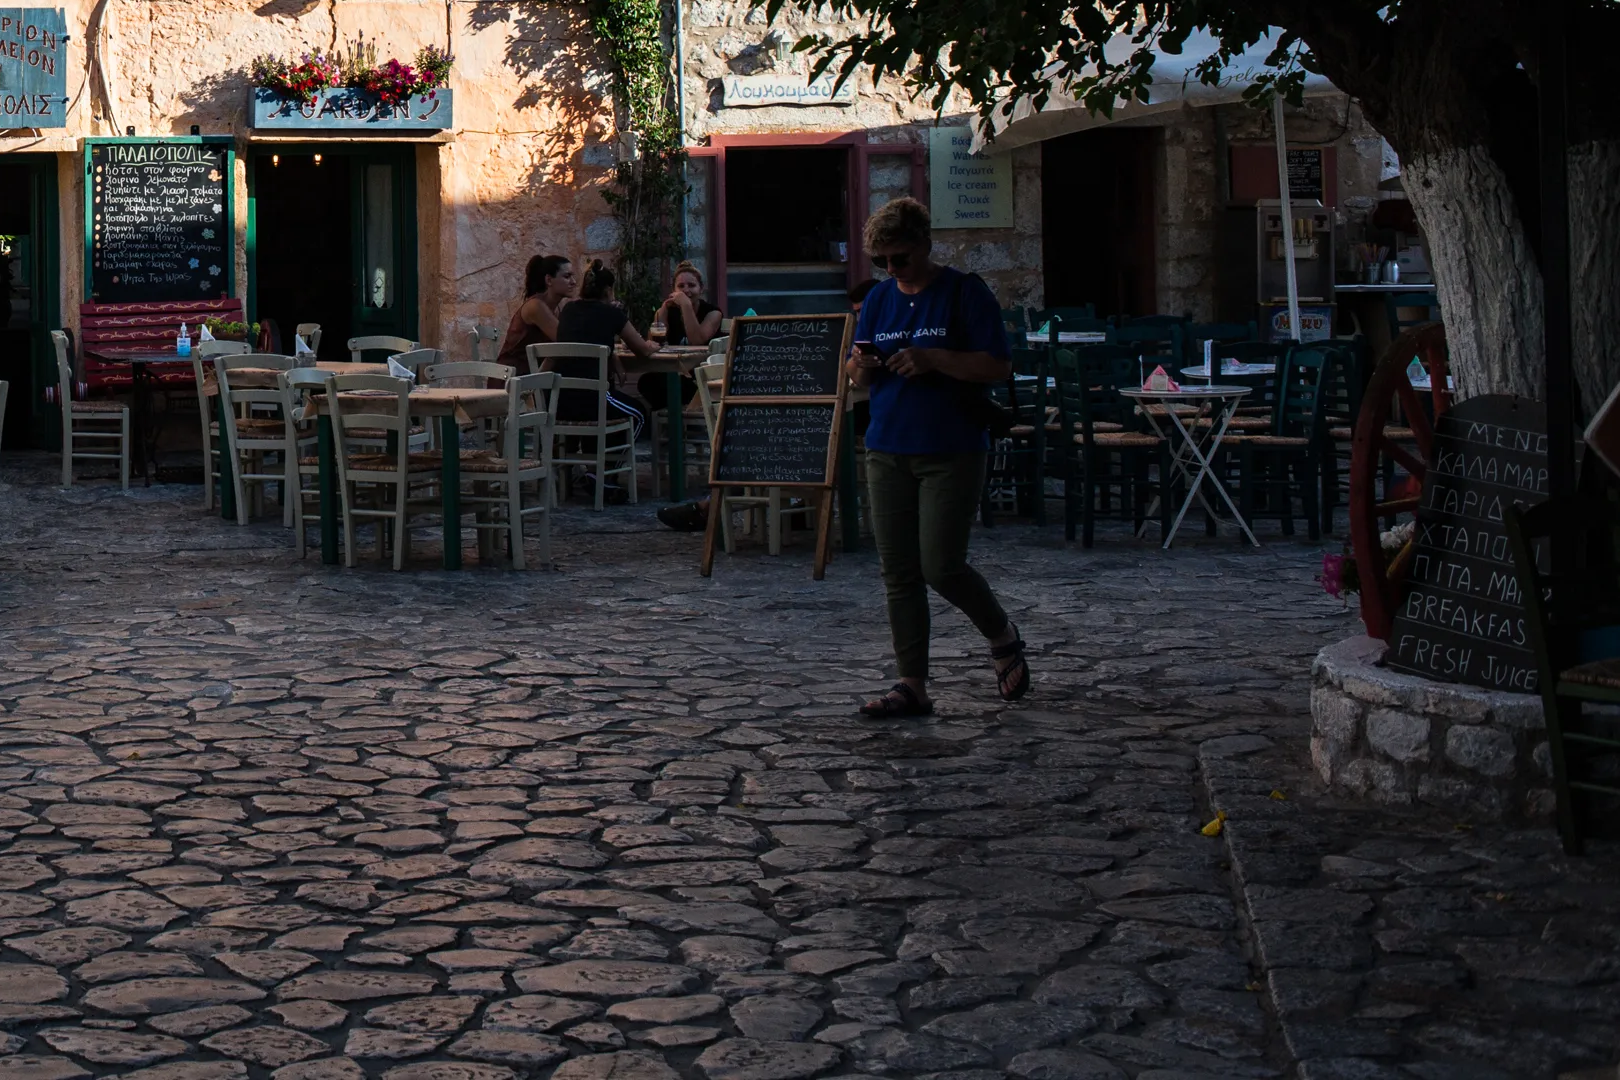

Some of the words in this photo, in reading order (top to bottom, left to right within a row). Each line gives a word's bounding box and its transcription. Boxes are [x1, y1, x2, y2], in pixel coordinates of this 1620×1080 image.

[299, 98, 411, 120] GARDEN
[106, 145, 217, 162] ΠΑΛΑΙΟΠΟΛΙΣ
[949, 165, 994, 176] Παγωτά
[144, 188, 156, 197] με
[948, 181, 961, 190] Ice
[965, 182, 996, 190] cream
[150, 197, 162, 206] με
[958, 195, 990, 204] Γλυκά
[154, 214, 167, 223] με
[954, 209, 990, 219] Sweets
[875, 331, 911, 342] TOMMY
[912, 328, 947, 338] JEANS
[1468, 422, 1548, 454] ΜΕΝΟ
[1436, 447, 1548, 489] ΚΑΛΑΜΑΡ
[1428, 485, 1534, 522] ΓΑΡΙΔ
[1419, 522, 1541, 565] ΧΤΑΠΟΙ
[1406, 591, 1527, 645] BREAKFAS
[1397, 634, 1472, 676] FRESH
[1481, 654, 1538, 691] JUICE
